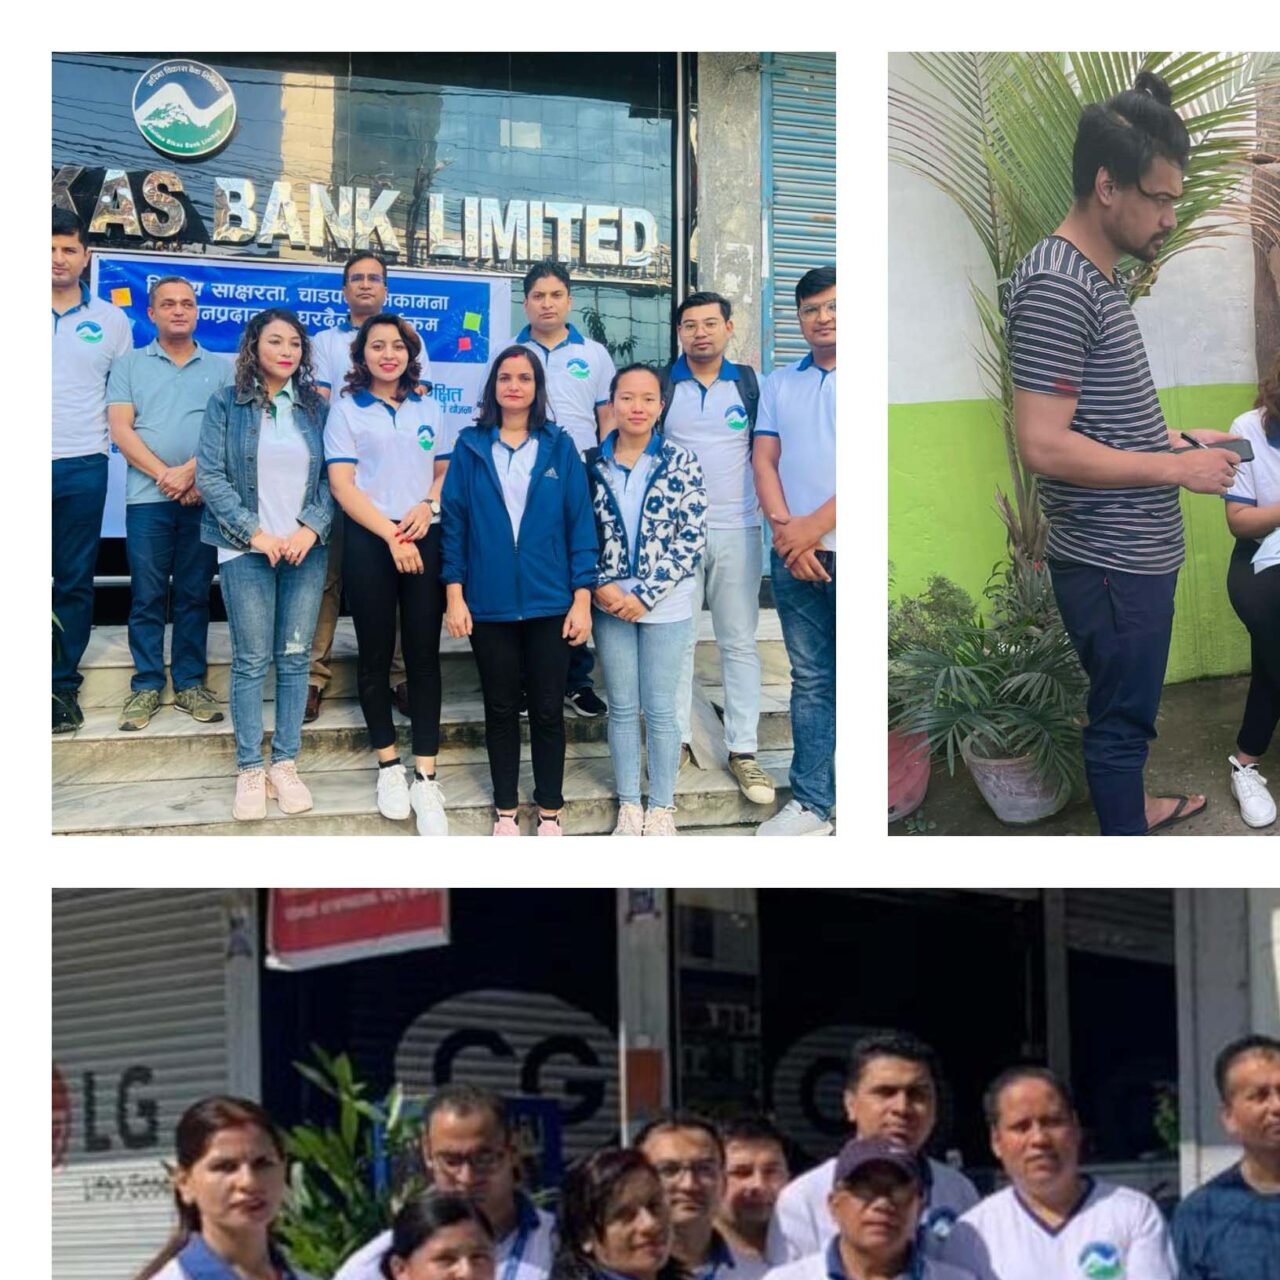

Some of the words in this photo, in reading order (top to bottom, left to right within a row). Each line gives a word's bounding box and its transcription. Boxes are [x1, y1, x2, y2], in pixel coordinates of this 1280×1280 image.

[213, 176, 400, 251] BANK
[429, 193, 657, 267] LIMITED
[84, 1065, 159, 1152] LG
